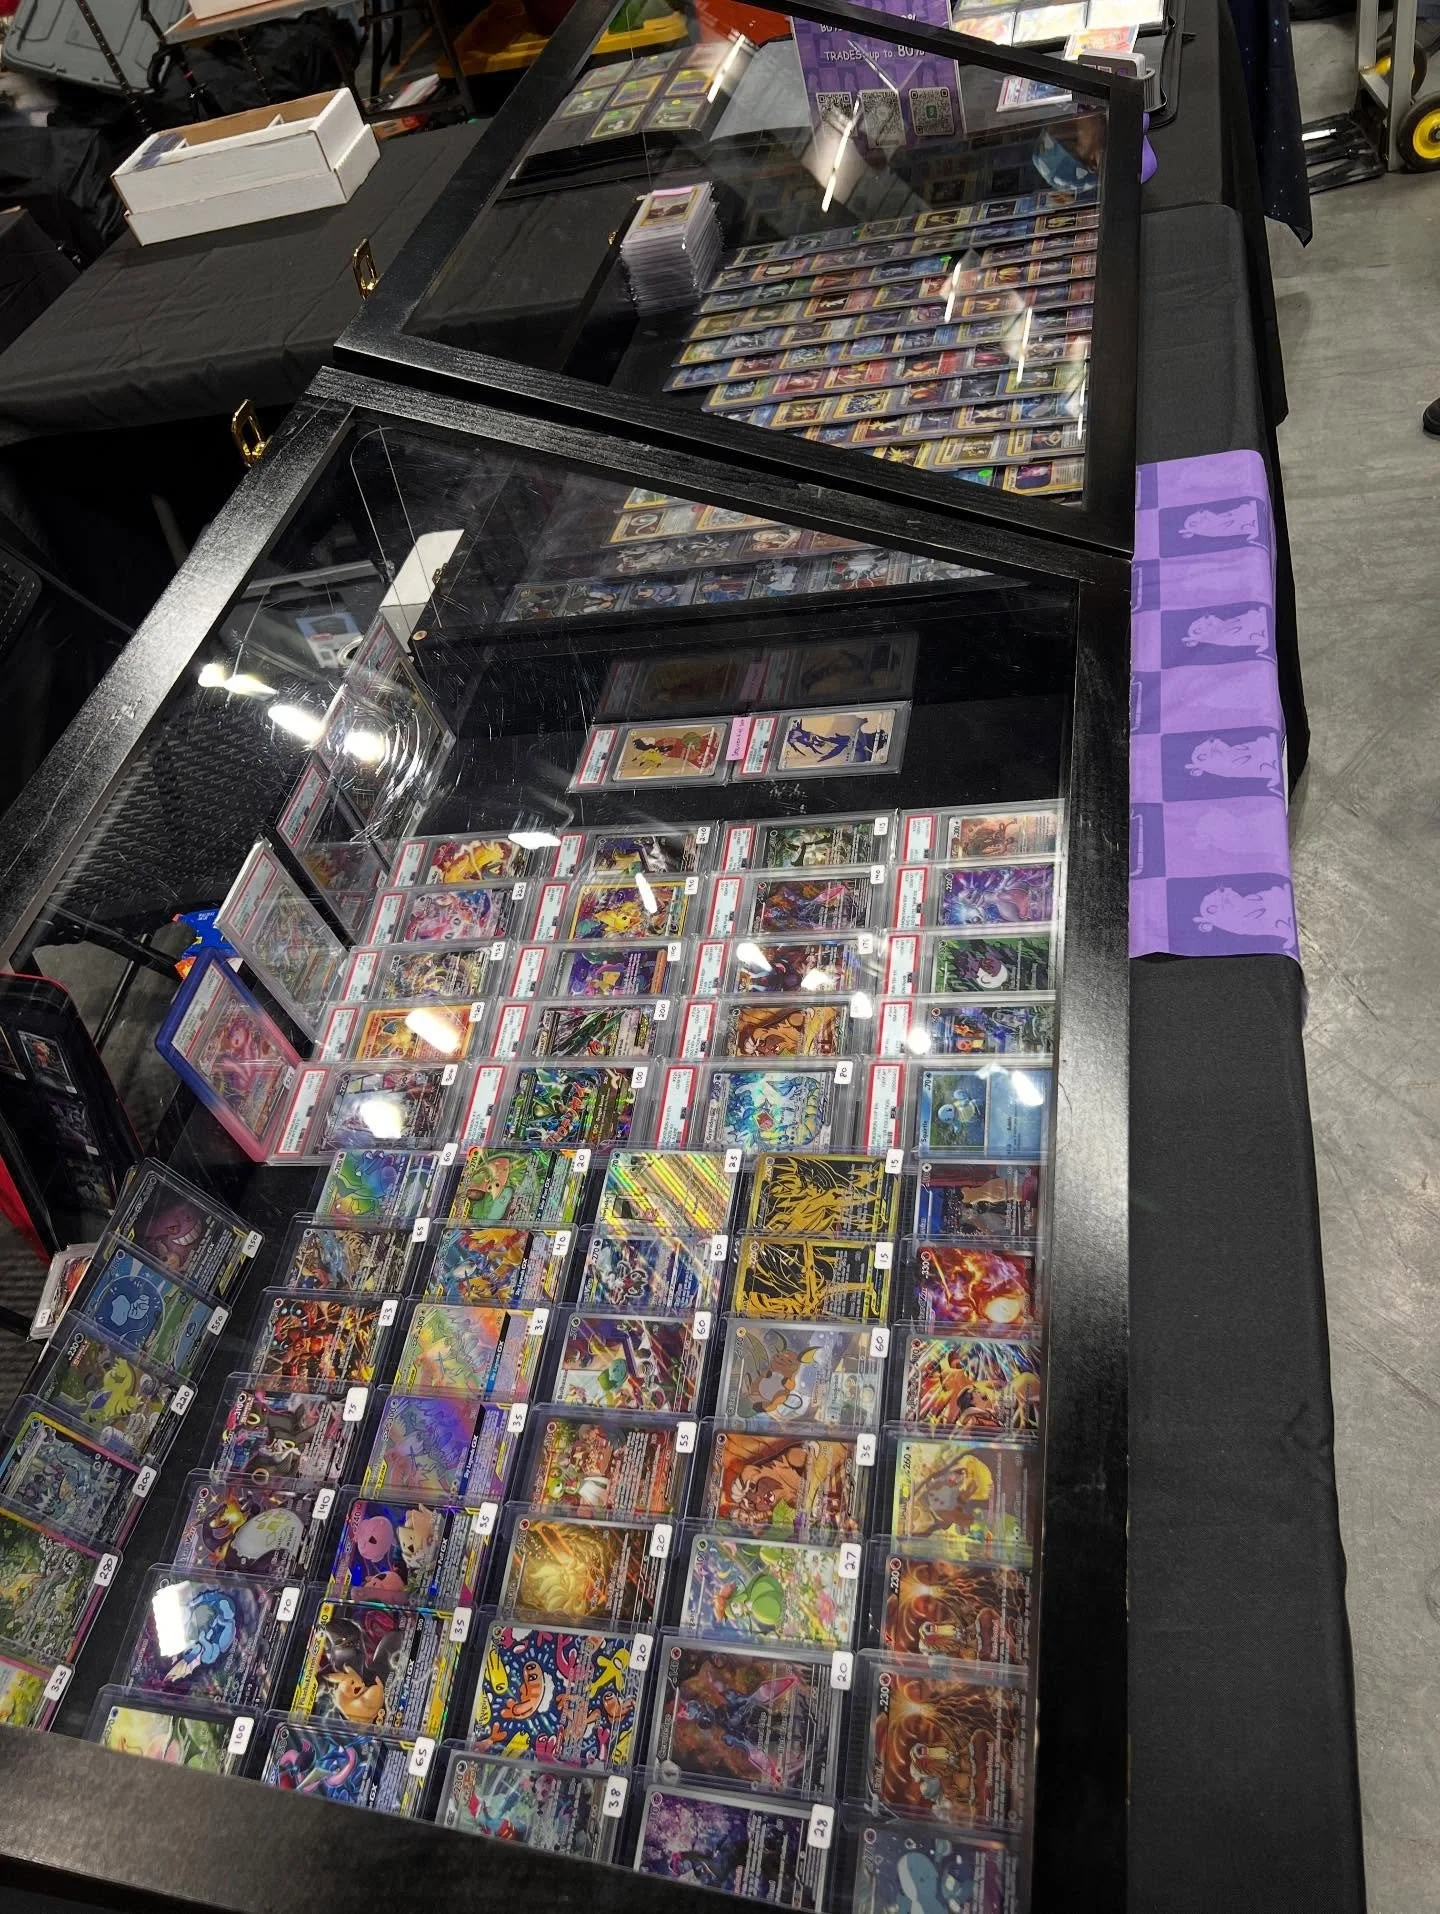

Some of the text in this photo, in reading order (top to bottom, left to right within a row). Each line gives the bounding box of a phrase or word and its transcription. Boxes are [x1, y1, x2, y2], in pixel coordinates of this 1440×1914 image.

[869, 51, 880, 61] up
[884, 49, 893, 58] to
[699, 828, 708, 842] 240
[516, 885, 524, 898] 225
[658, 1003, 667, 1018] 200
[634, 1071, 644, 1085] 100
[840, 1067, 849, 1078] 80
[919, 1120, 928, 1143] Squirtle
[443, 1152, 452, 1162] 60
[575, 1155, 585, 1168] 20
[729, 1156, 737, 1168] 25
[890, 1159, 899, 1169] 15
[417, 1226, 424, 1236] 65
[247, 1234, 258, 1250] 950
[556, 1236, 566, 1250] 40
[592, 1247, 600, 1260] 270
[714, 1243, 723, 1257] 50
[881, 1253, 889, 1263] 15
[921, 1261, 929, 1275] 330
[383, 1307, 392, 1319] 23
[211, 1315, 223, 1331] 550
[415, 1316, 425, 1330] 300
[534, 1319, 543, 1331] 35
[698, 1320, 706, 1335] 60
[68, 1342, 79, 1356] 230
[875, 1335, 884, 1352] 60
[348, 1403, 357, 1415] 75
[512, 1415, 522, 1427] 35
[471, 1435, 479, 1449] GX
[679, 1434, 688, 1447] 55
[862, 1445, 870, 1458] 35
[902, 1454, 911, 1470] 260
[137, 1472, 150, 1491] 200
[319, 1496, 331, 1514] 140
[655, 1533, 664, 1551] 20
[844, 1552, 856, 1571] 27
[99, 1559, 113, 1580] 280
[890, 1570, 899, 1589] 230
[284, 1598, 292, 1613] 70
[454, 1619, 464, 1634] 35
[636, 1645, 646, 1661] 20
[406, 1658, 415, 1676] GX
[836, 1663, 848, 1682] 20
[50, 1671, 66, 1693] 325
[880, 1686, 890, 1707] 230
[234, 1725, 246, 1745] 100
[416, 1749, 427, 1766] 65
[454, 1775, 463, 1793] 230
[609, 1788, 620, 1809] 38
[815, 1819, 828, 1837] 28
